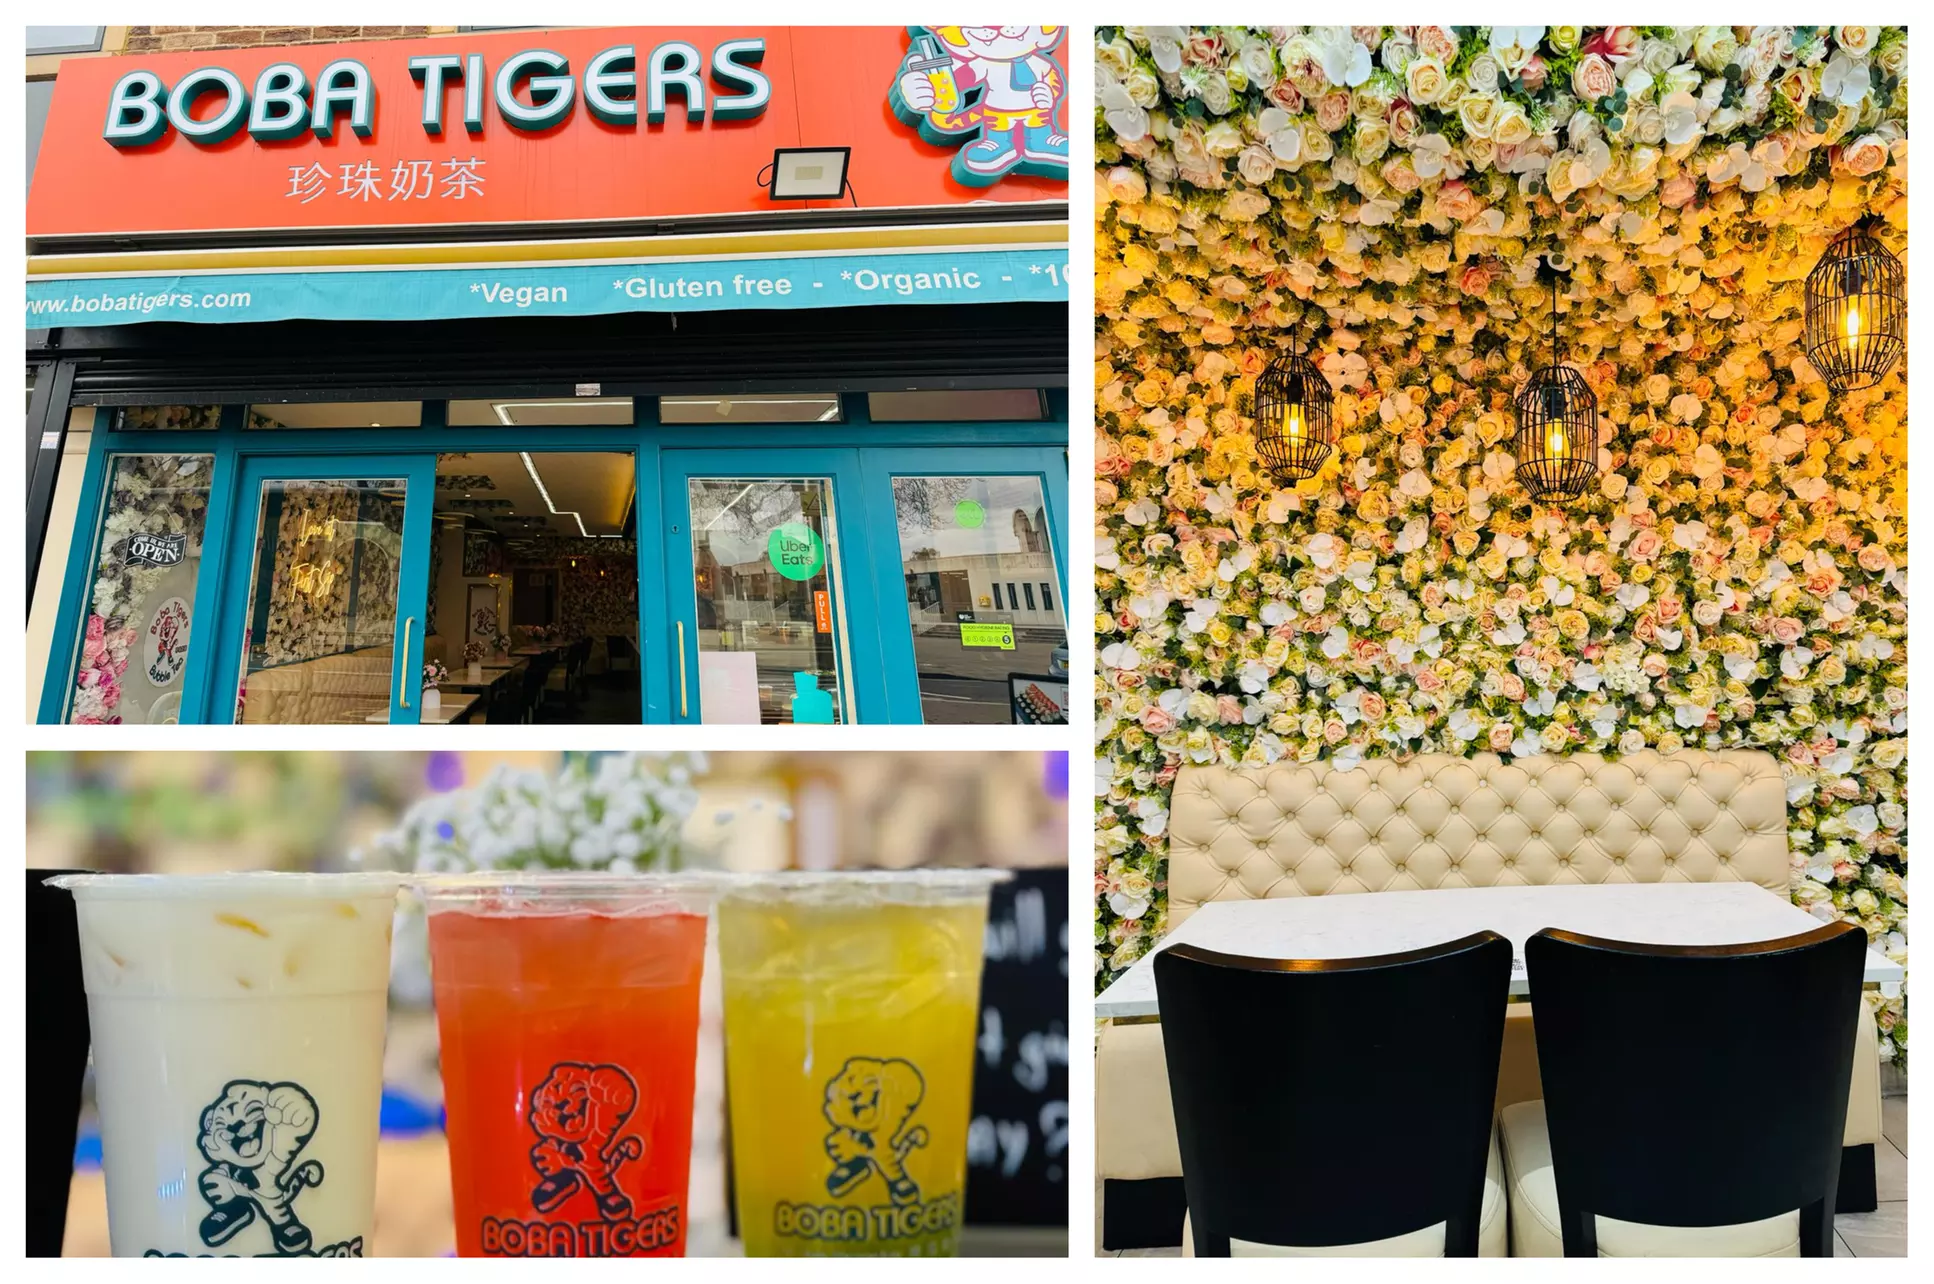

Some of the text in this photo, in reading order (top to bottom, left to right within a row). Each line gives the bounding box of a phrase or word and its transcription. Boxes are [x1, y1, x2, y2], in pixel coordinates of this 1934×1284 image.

[103, 37, 772, 147] BOBA TIGERS
[286, 156, 486, 204] 珍珠奶茶
[733, 274, 793, 295] free
[132, 542, 178, 562] OPEN
[780, 540, 812, 552] Uber
[781, 553, 814, 566] Eats
[818, 593, 826, 621] PULL
[481, 1204, 679, 1257] BOBA TIGERS
[775, 1199, 869, 1241] BOBA
